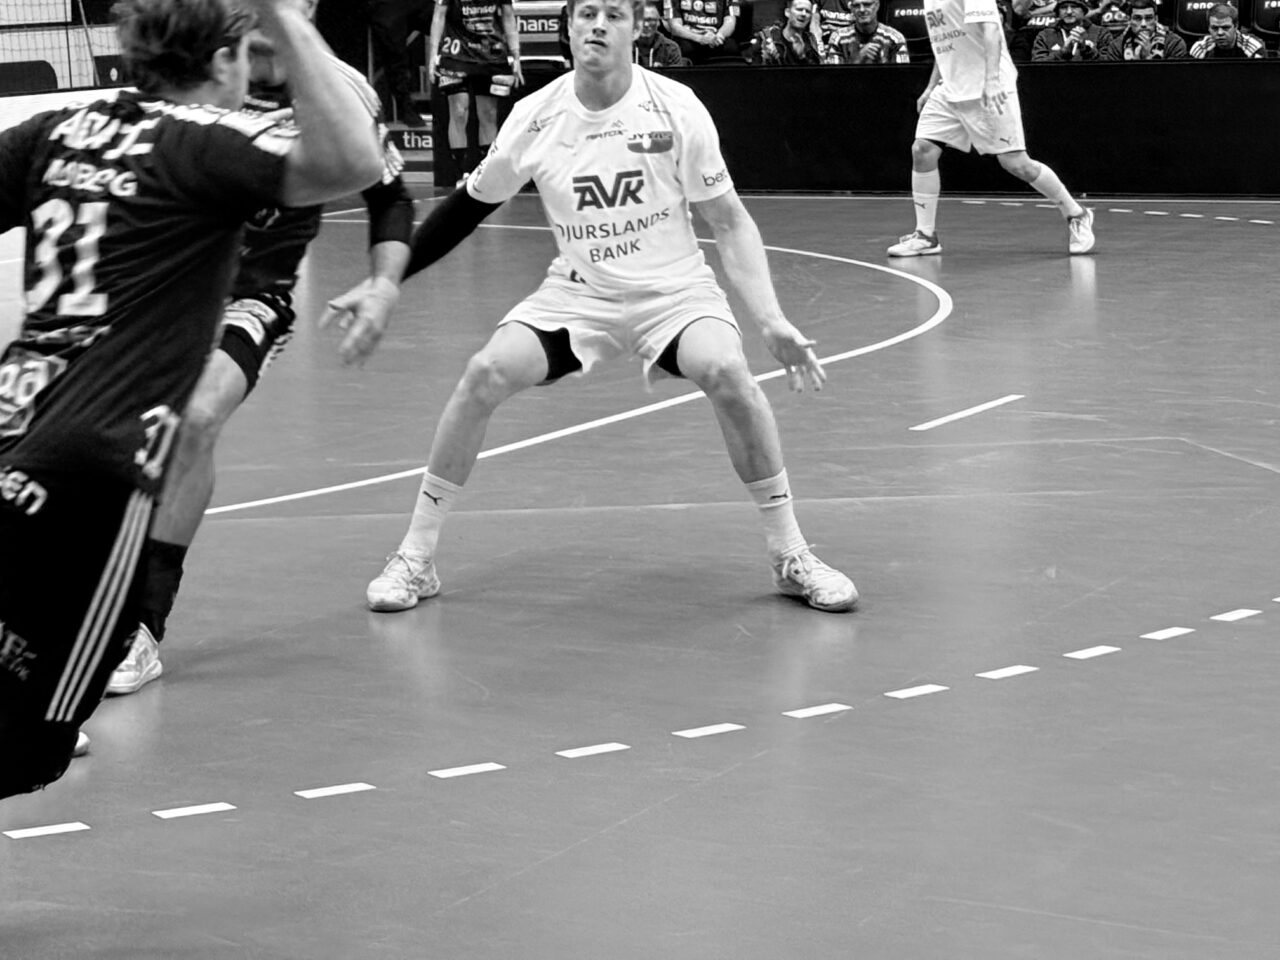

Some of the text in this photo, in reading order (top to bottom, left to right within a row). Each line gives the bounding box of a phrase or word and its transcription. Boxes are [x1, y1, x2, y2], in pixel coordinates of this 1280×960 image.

[517, 16, 560, 32] hans
[442, 36, 461, 55] 20
[572, 170, 644, 211] AVK
[590, 239, 641, 263] BANK
